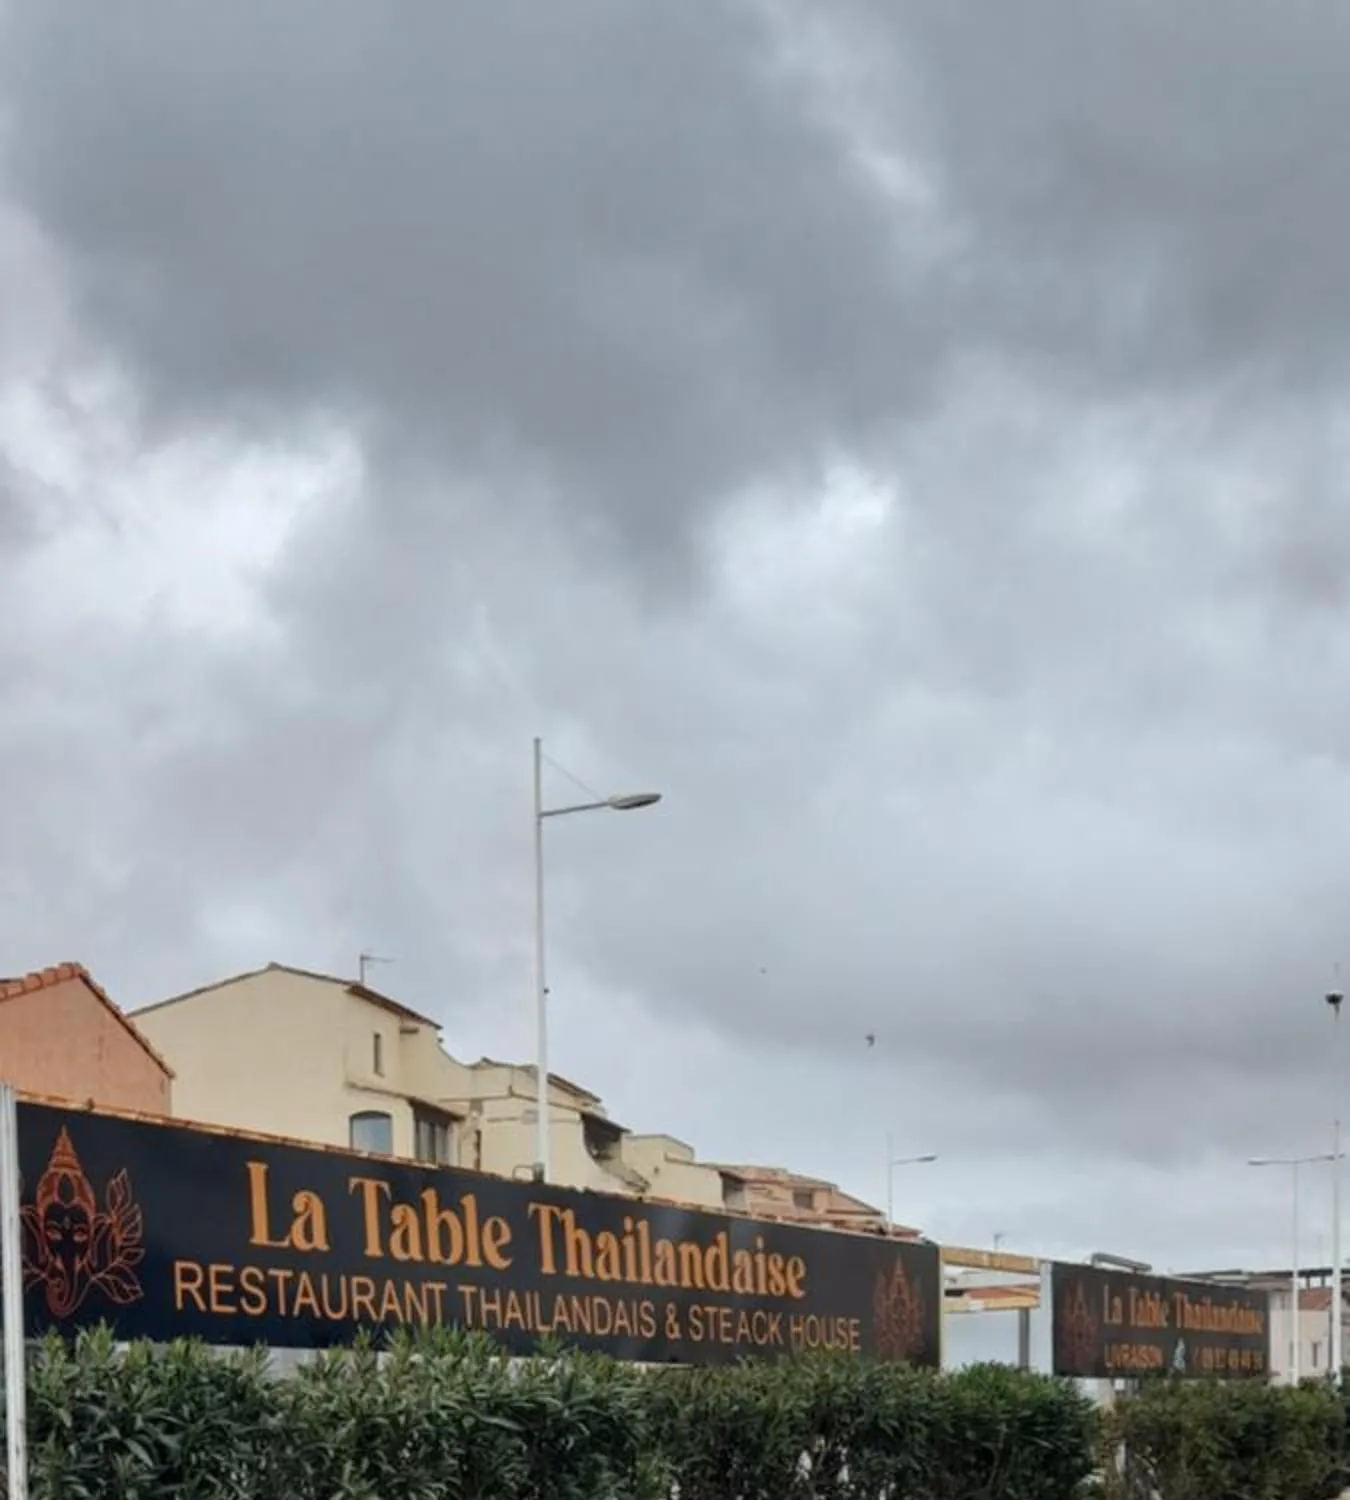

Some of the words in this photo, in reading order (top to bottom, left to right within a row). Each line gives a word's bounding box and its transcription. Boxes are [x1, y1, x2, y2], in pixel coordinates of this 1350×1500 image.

[247, 1161, 330, 1251] La
[349, 1177, 513, 1268] Table
[528, 1202, 807, 1298] Thailandaise
[174, 1260, 447, 1325] RESTAURANT
[457, 1284, 655, 1339] THAILANDAIS
[665, 1306, 681, 1341] &
[688, 1304, 784, 1346] STEACK
[789, 1315, 862, 1351] HOUSE
[1103, 1284, 1123, 1324] La
